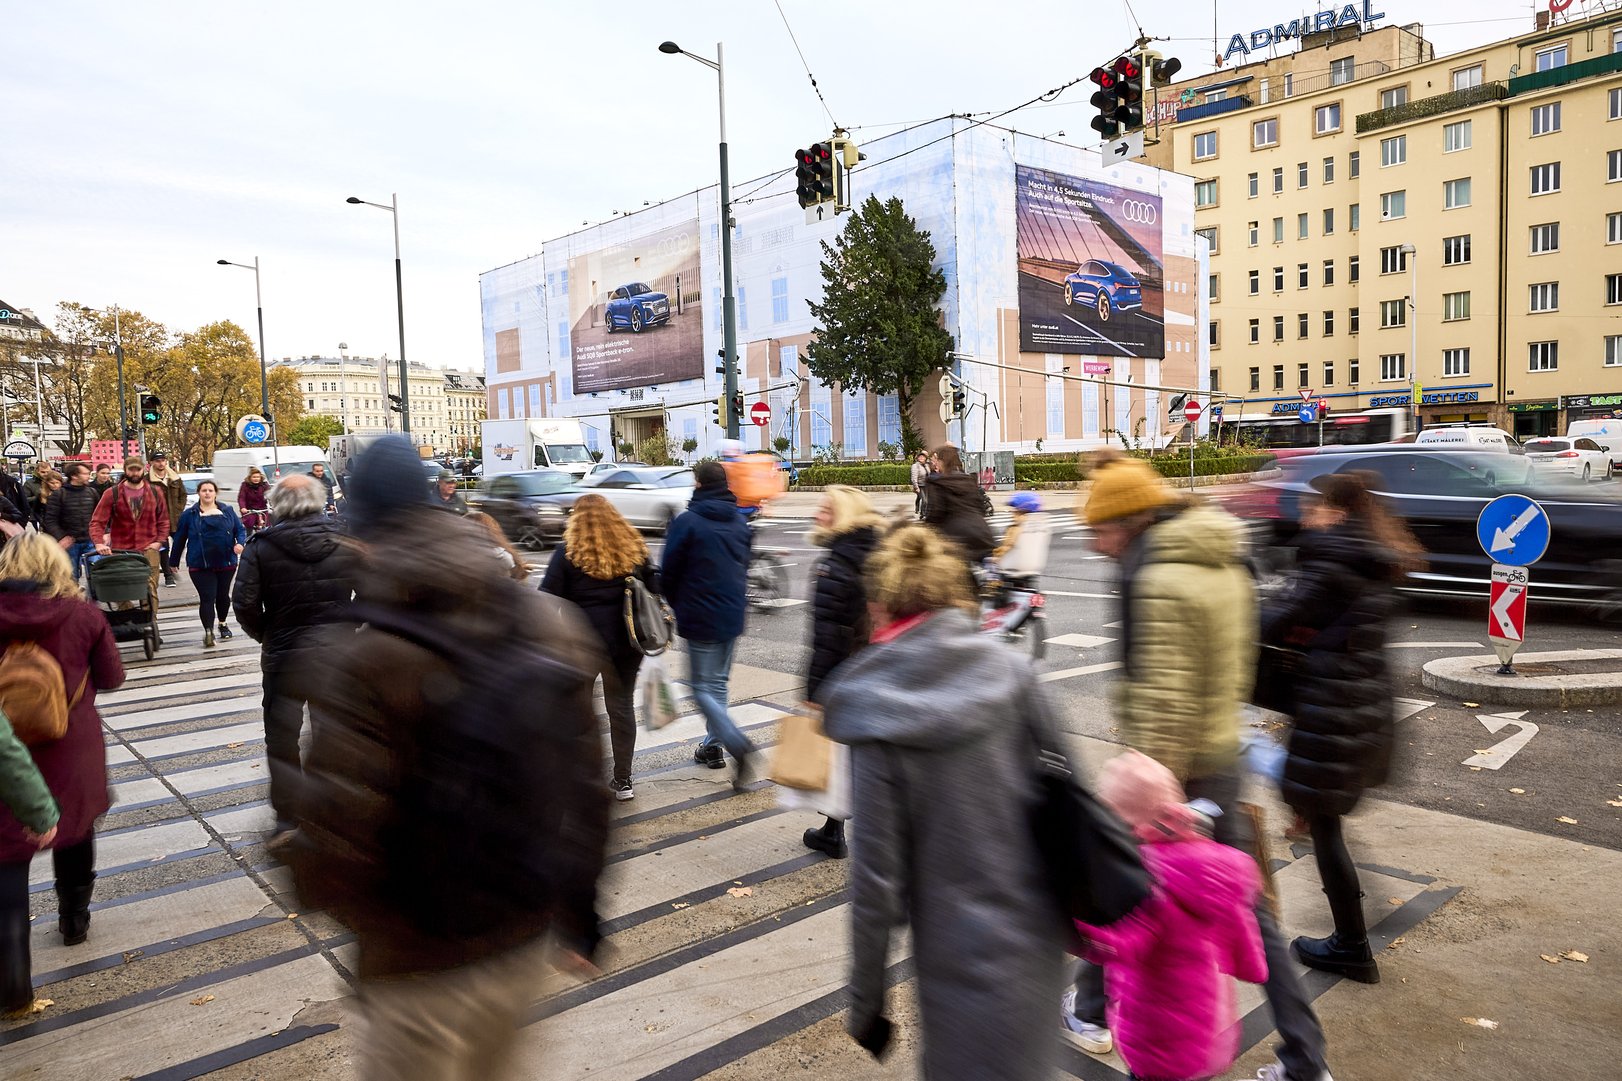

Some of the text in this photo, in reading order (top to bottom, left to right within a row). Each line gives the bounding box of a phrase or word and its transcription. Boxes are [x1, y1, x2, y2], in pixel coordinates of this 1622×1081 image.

[1223, 0, 1385, 60] ADMIRAL
[1028, 180, 1046, 190] Macht
[1054, 186, 1063, 194] 4,5
[1064, 188, 1091, 199] Sekunden
[1092, 192, 1115, 204] Eindruck.
[1028, 190, 1043, 199] Auch
[1064, 198, 1093, 208] Sportsitze.
[605, 340, 630, 348] elektrische
[596, 350, 618, 359] Sportback
